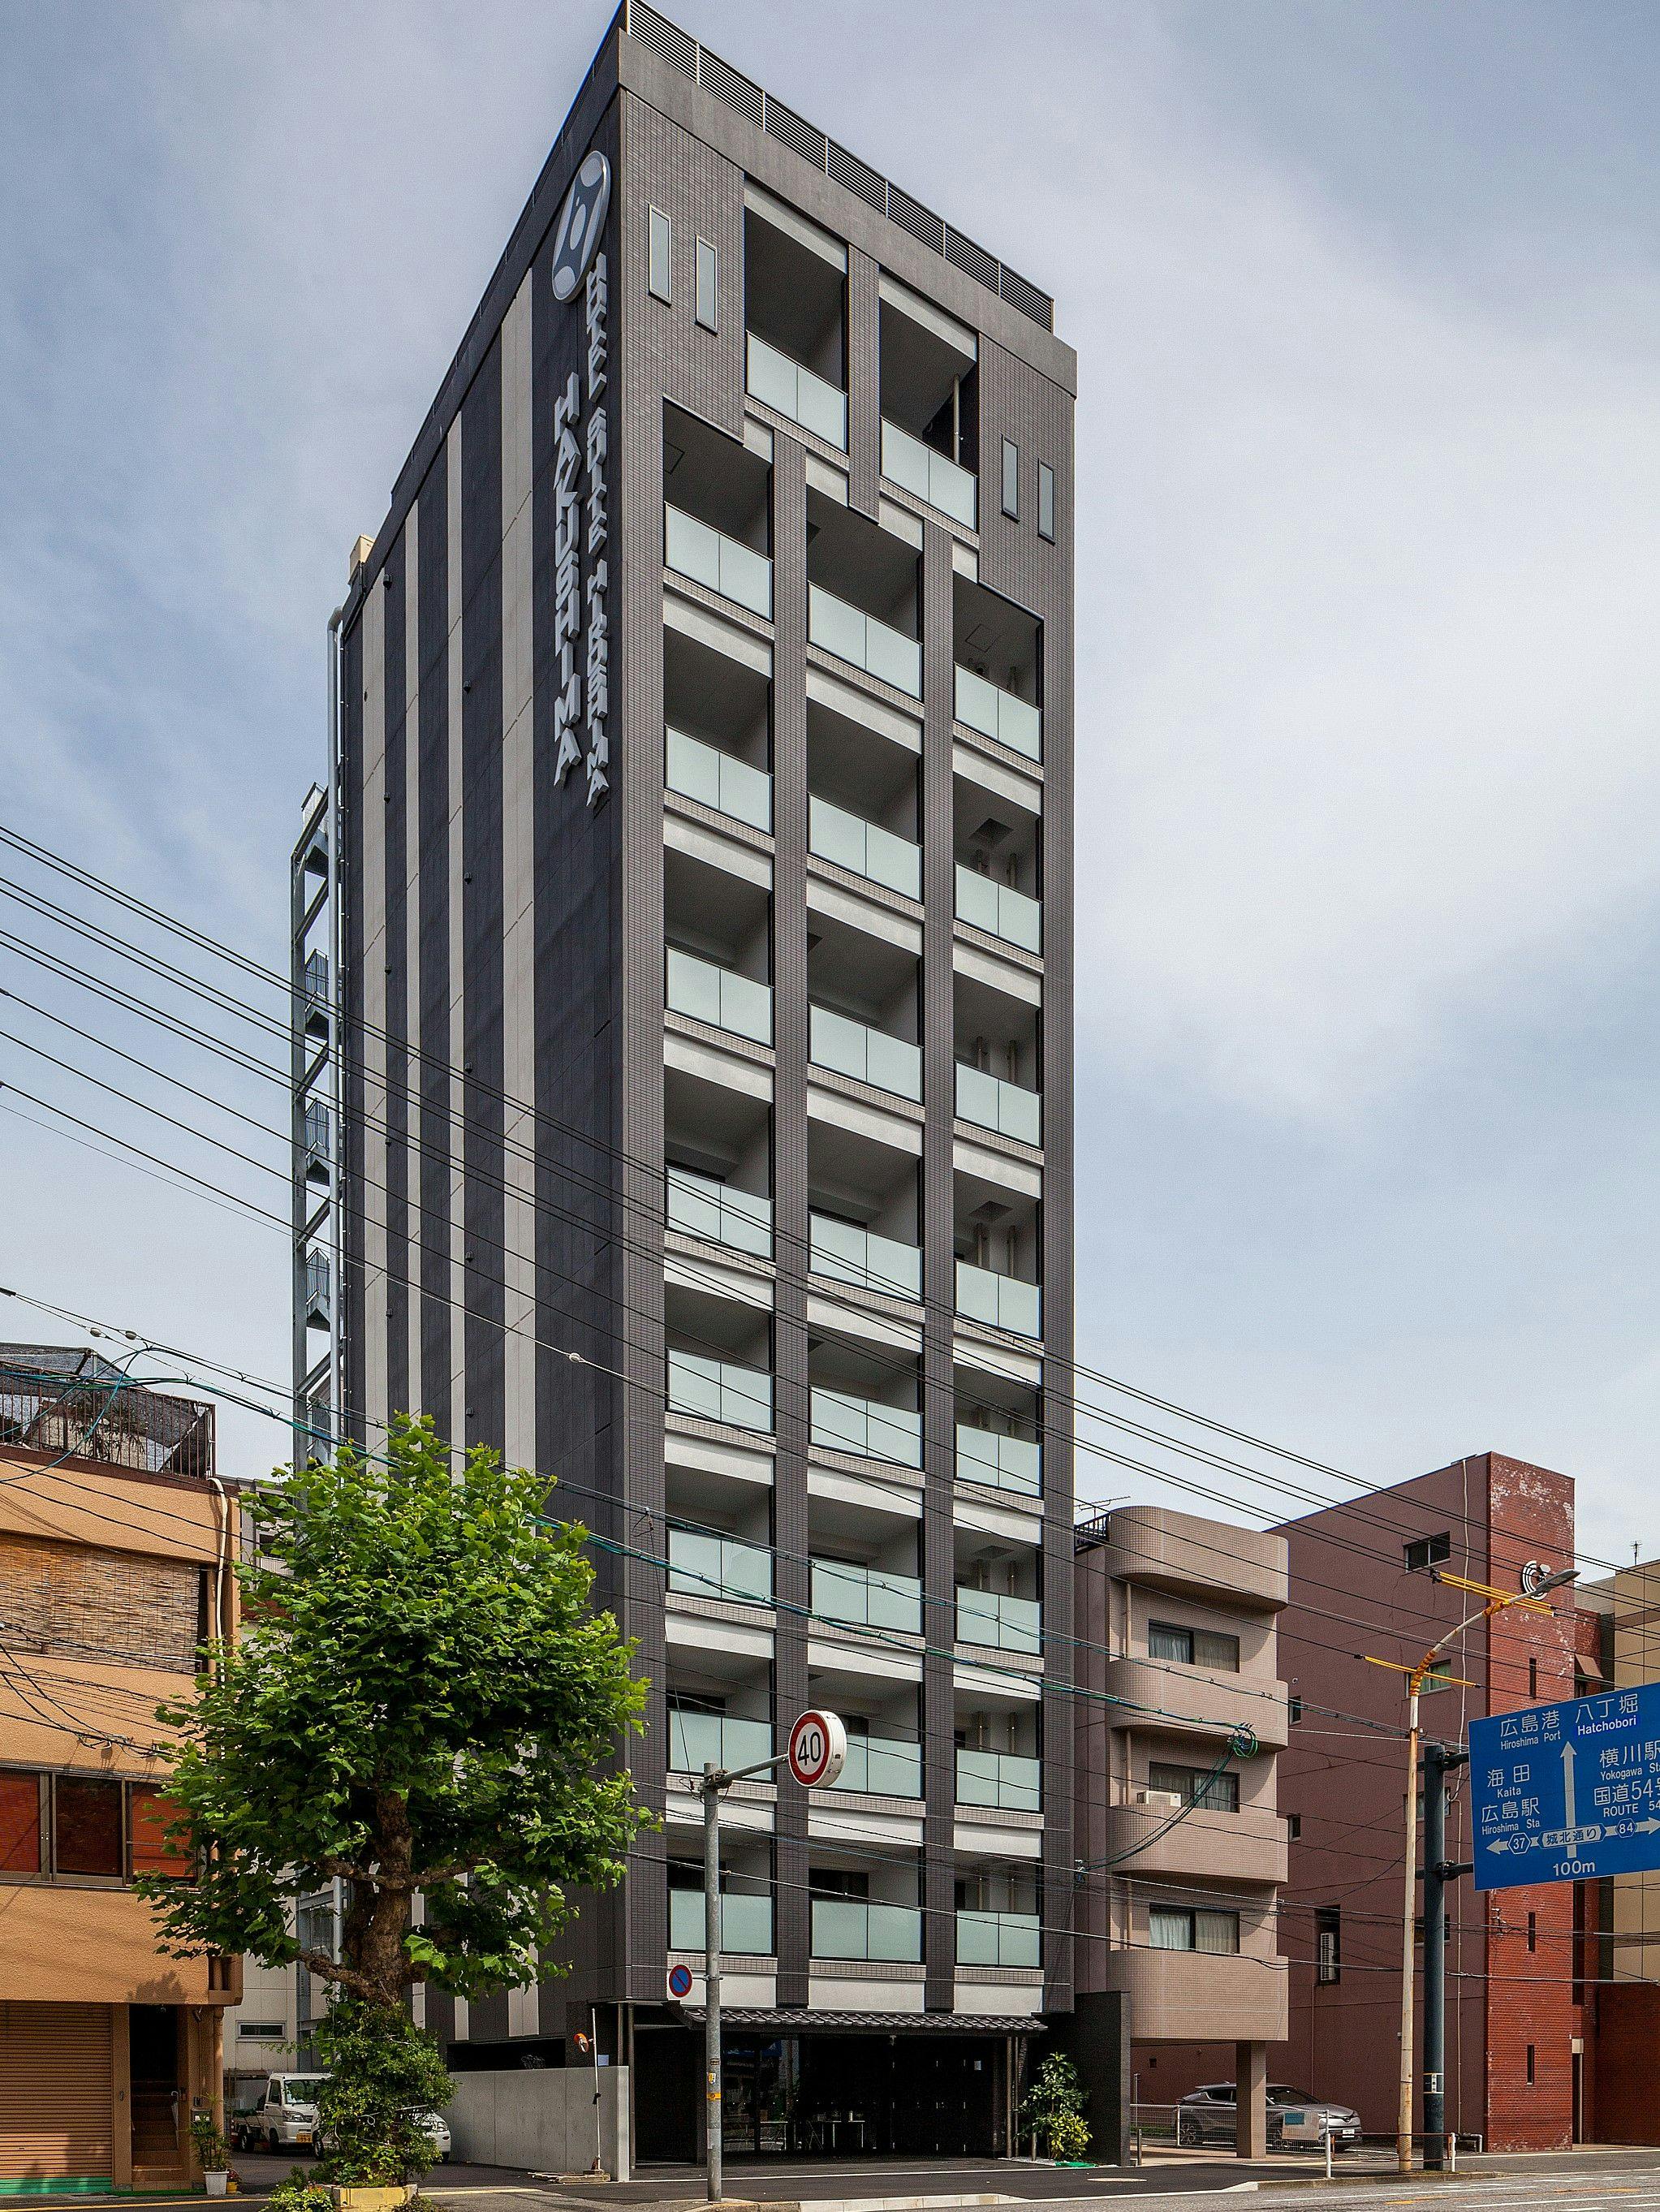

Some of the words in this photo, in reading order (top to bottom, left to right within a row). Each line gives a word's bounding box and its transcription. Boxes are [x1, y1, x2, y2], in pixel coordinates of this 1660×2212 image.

[586, 252, 607, 403] HOTEL
[587, 407, 608, 557] SUITE
[554, 371, 582, 787] HAKUSHIMA
[586, 558, 609, 808] HIROSHIMA
[1576, 1693, 1638, 1723] 八丁堀
[1500, 1710, 1560, 1737] 広島港
[1577, 1714, 1637, 1736] Hatchobori
[797, 1731, 821, 1766] 40
[1500, 1736, 1539, 1750] Hiroshima
[1544, 1730, 1561, 1743] Port
[1599, 1740, 1660, 1769] 横川駅
[1487, 1764, 1530, 1787] 海田
[1600, 1767, 1643, 1781] Yokogawa
[1649, 1761, 1660, 1774] St
[1497, 1786, 1522, 1798] Kaita
[1481, 1796, 1541, 1823] 広島駅
[1603, 1803, 1639, 1818] ROUTE
[1649, 1800, 1660, 1811] 54
[1481, 1822, 1520, 1835] Hiroshima
[1526, 1818, 1540, 1830] Sta
[1546, 1828, 1597, 1846] 城北通り
[1619, 1822, 1634, 1835] 84
[1513, 1837, 1526, 1850] 37
[1553, 1860, 1596, 1877] 100m
